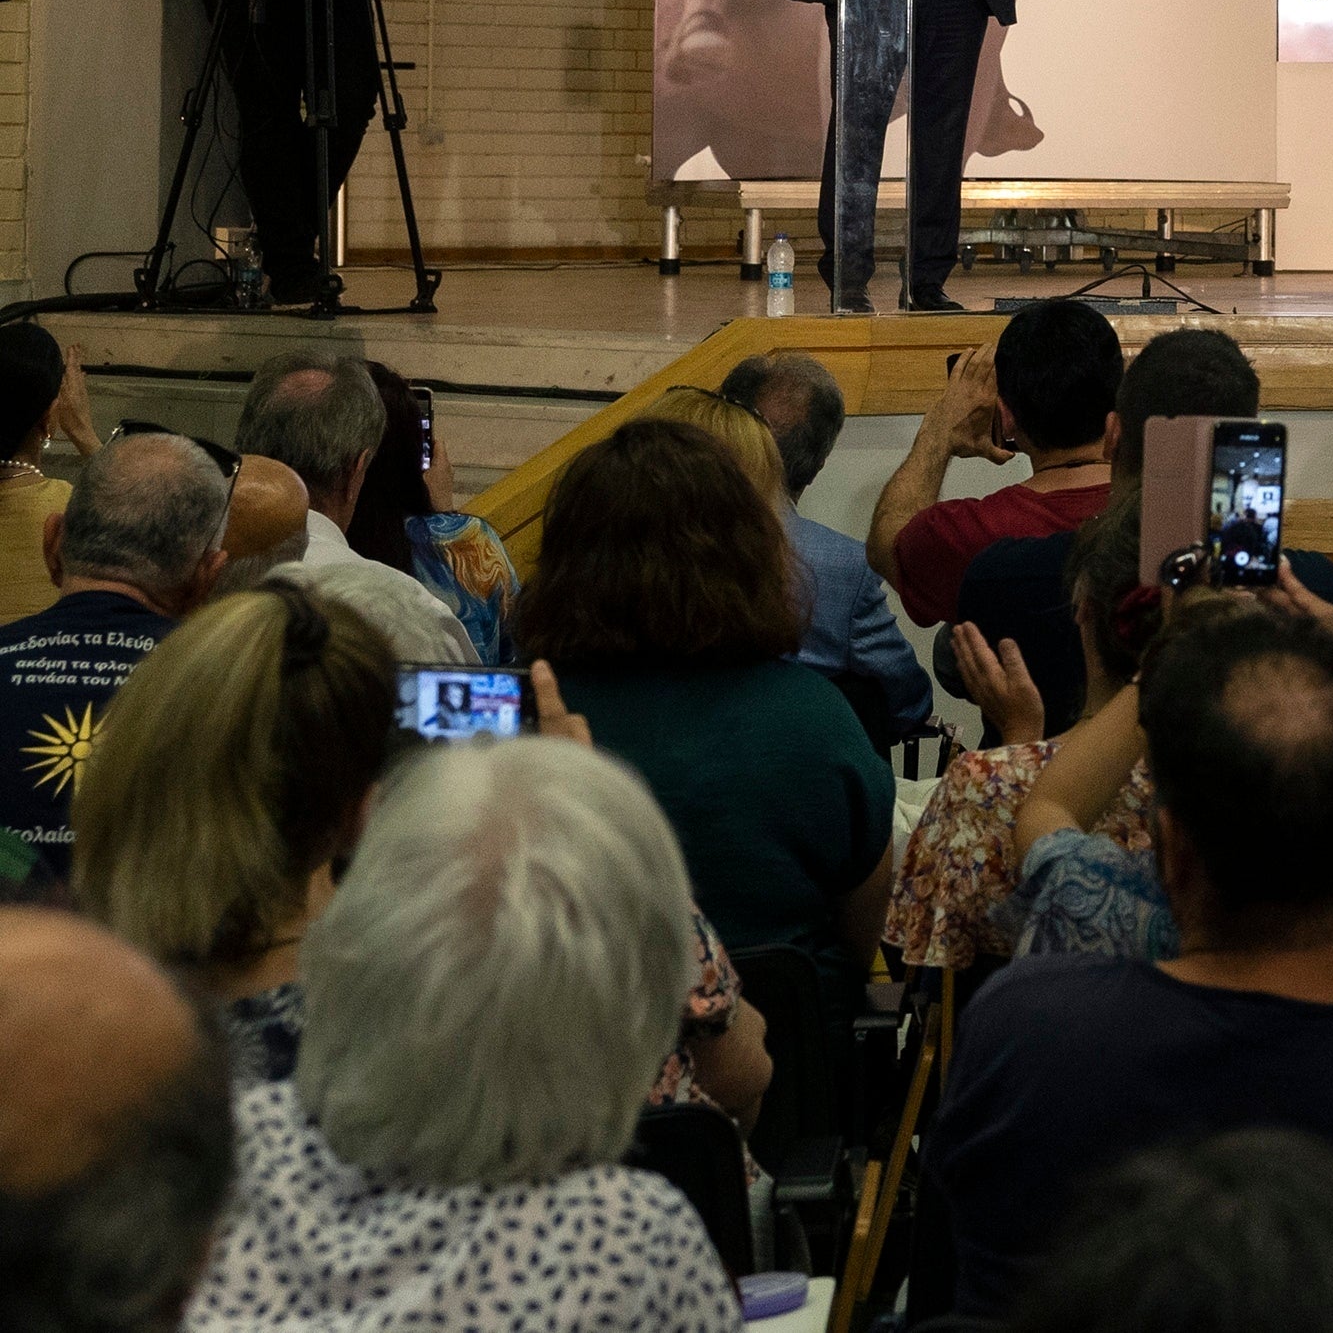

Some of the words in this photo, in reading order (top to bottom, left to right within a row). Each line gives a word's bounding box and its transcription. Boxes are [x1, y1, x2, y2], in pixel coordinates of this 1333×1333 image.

[0, 631, 80, 655] ακεδονίας
[83, 633, 103, 645] τα
[106, 632, 157, 652] Ελεύθ
[16, 657, 67, 671] ακόμη
[70, 660, 91, 669] τα
[94, 660, 138, 673] φλογ
[25, 672, 78, 685] ανάσα
[81, 676, 111, 686] του
